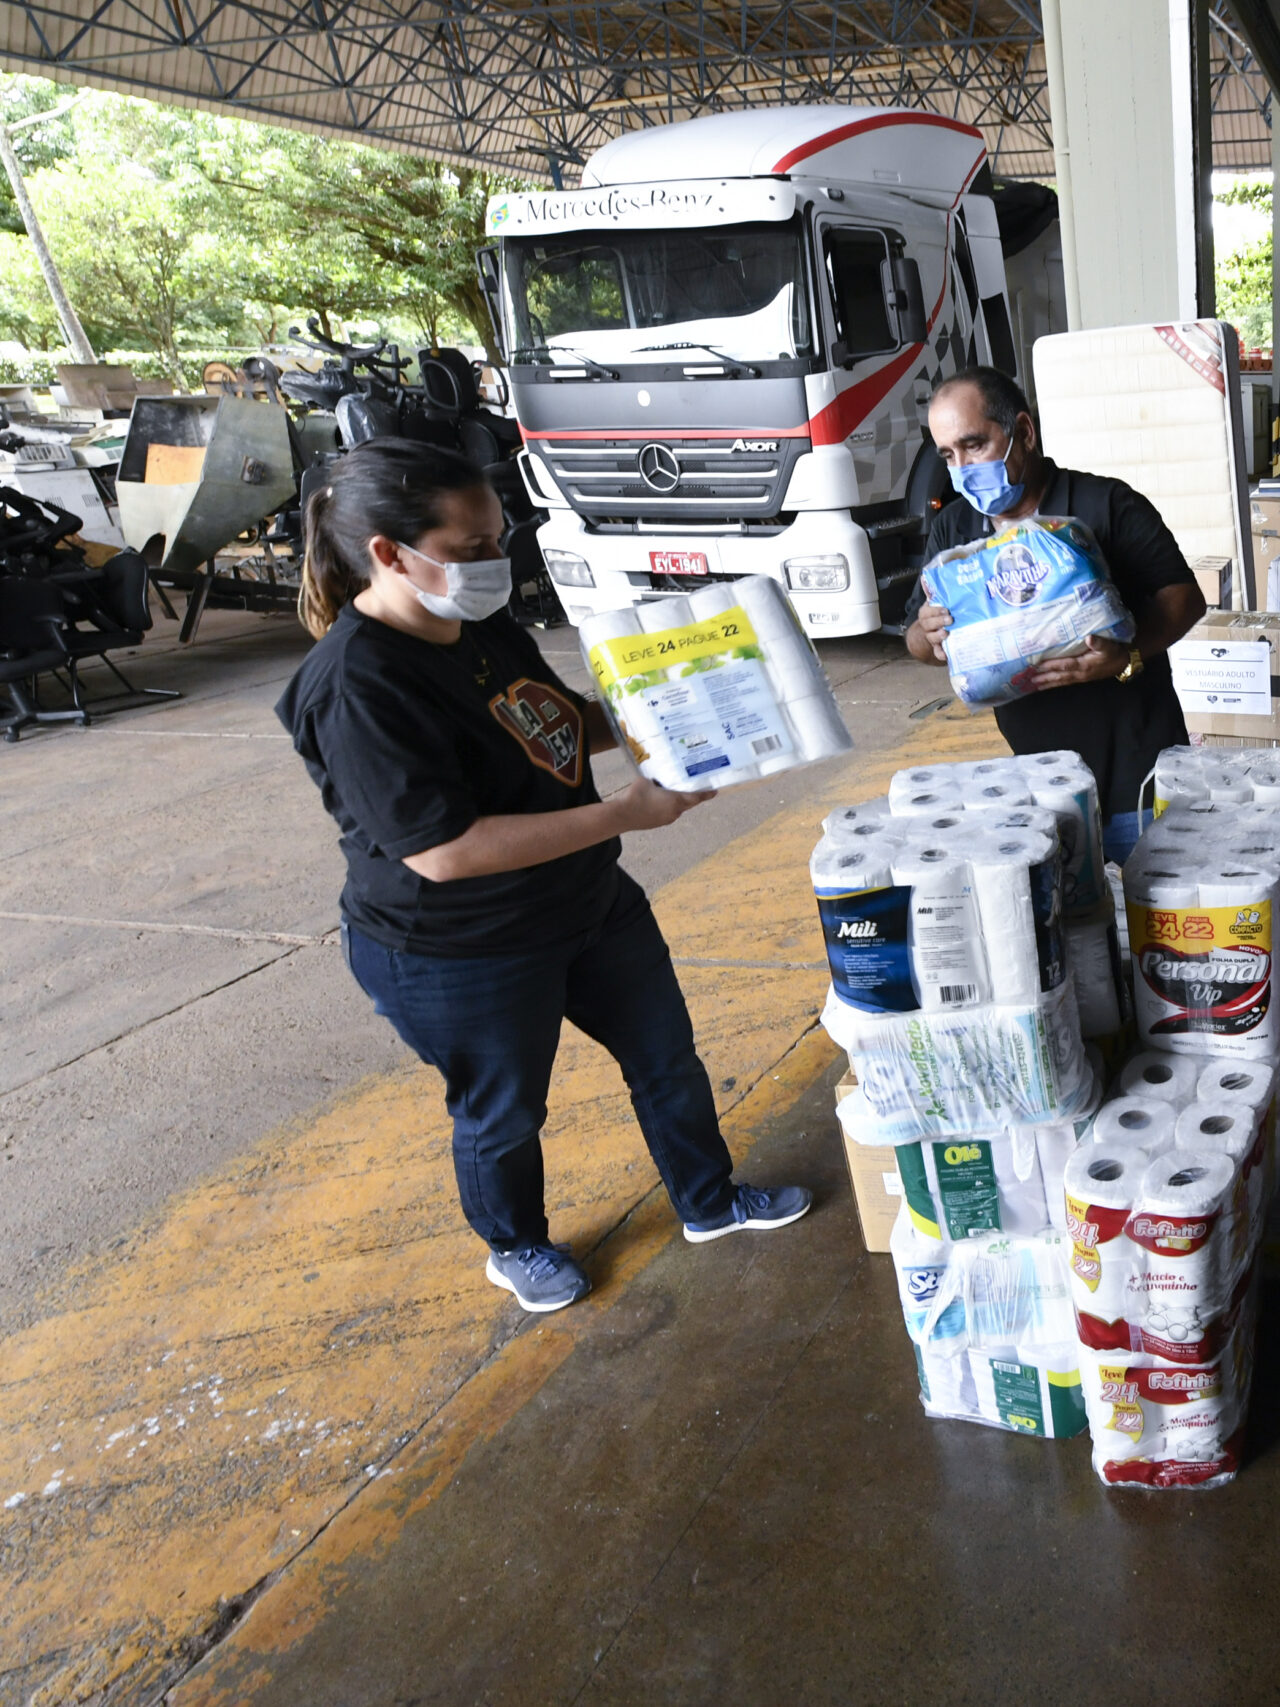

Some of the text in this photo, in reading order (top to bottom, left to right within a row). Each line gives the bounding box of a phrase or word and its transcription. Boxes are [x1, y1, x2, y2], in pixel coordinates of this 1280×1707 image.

[526, 188, 713, 222] Mercedes-Benz
[622, 623, 740, 665] LEVE 24 PAGUE 22
[1199, 681, 1242, 690] MASCULINO
[1225, 671, 1256, 679] ADULTO
[1147, 912, 1176, 922] LEVE
[837, 920, 878, 939] Mili
[1147, 922, 1214, 940] 24 22
[1229, 924, 1263, 935] COMPACTO
[1142, 952, 1270, 984] Personal
[1189, 983, 1223, 1006] Vip
[944, 1143, 982, 1166] Olé
[1067, 1212, 1100, 1249] 24
[1133, 1218, 1207, 1240] Fofinho
[1073, 1255, 1100, 1281] 22
[1101, 1368, 1122, 1379] Leve
[1100, 1381, 1139, 1405] 24
[1115, 1411, 1142, 1433] 22
